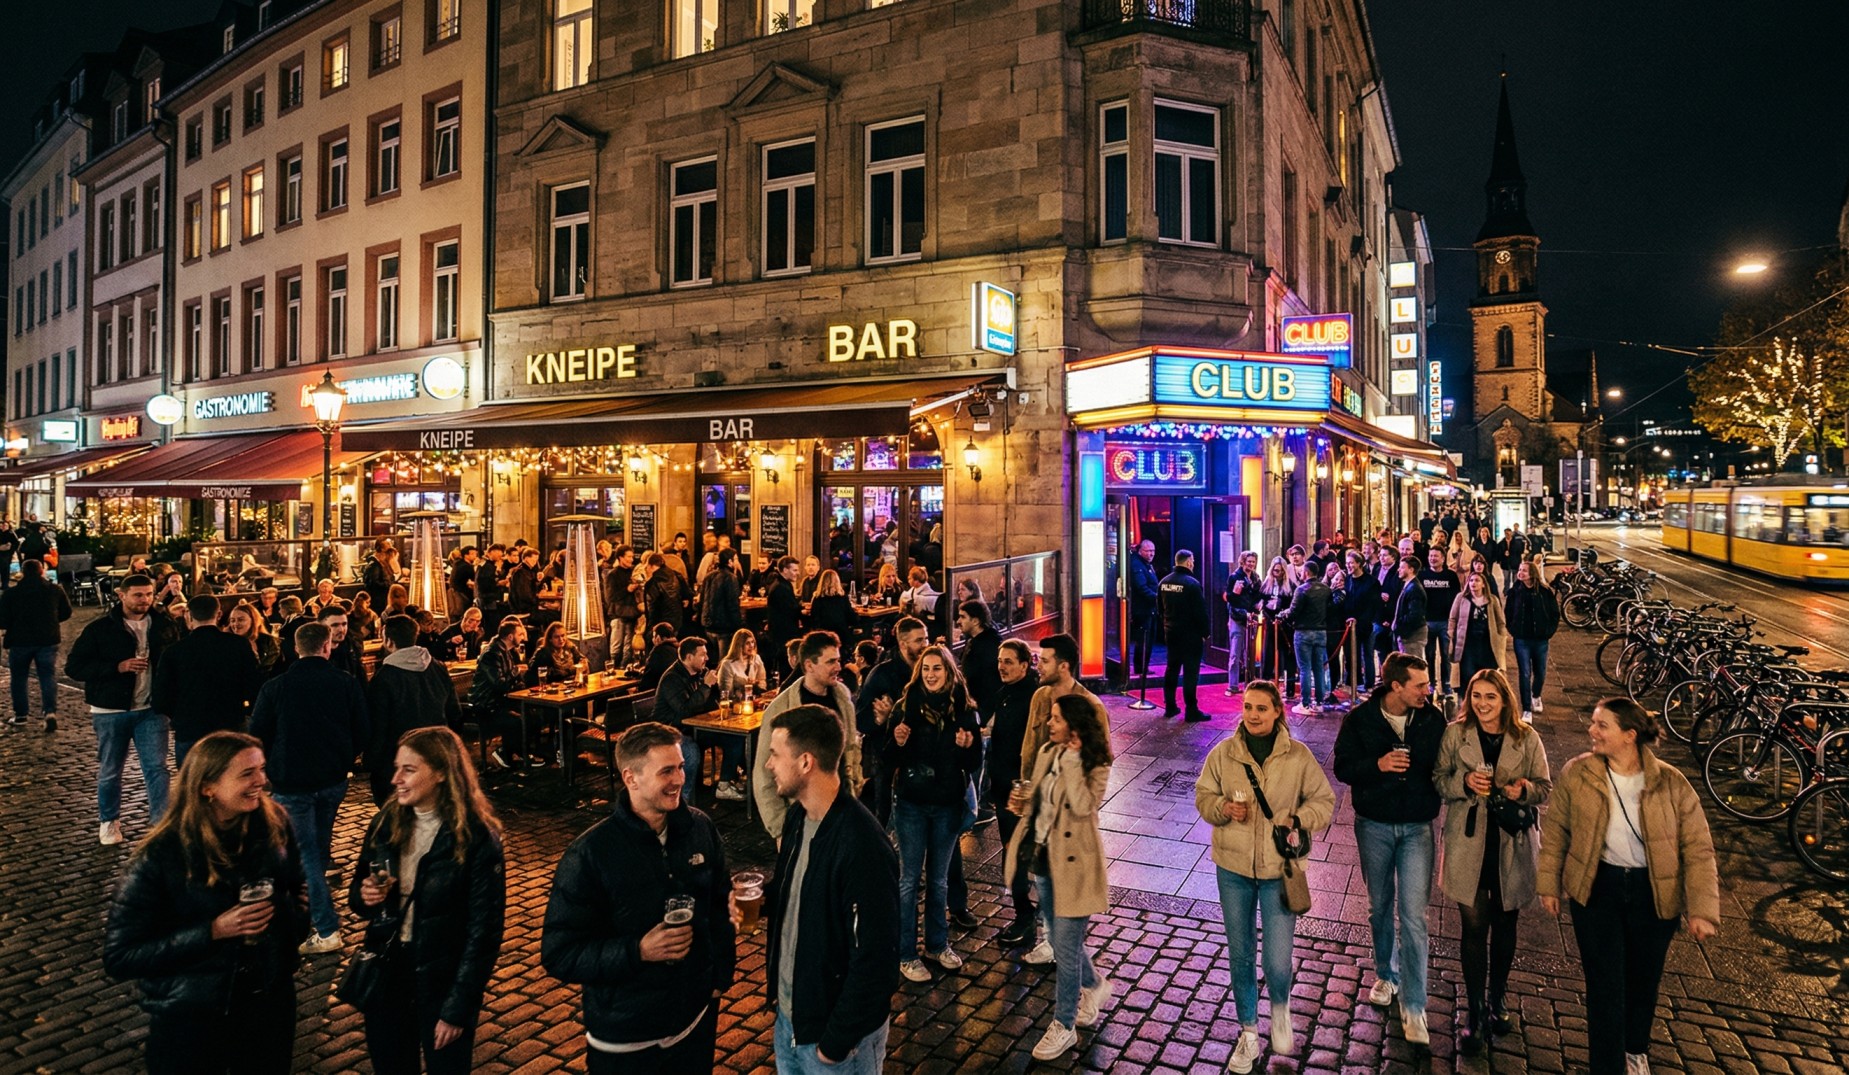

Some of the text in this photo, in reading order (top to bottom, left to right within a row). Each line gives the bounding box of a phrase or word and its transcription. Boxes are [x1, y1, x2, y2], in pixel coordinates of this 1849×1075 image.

[829, 319, 917, 363] BAR
[1284, 320, 1350, 346] CLUB
[526, 344, 636, 385] KNEIPE
[1191, 361, 1296, 401] CLUB
[194, 391, 270, 419] GASTRONOMIE
[420, 430, 474, 449] KNEIPE
[709, 418, 754, 441] BAR
[1112, 449, 1197, 482] CLUB
